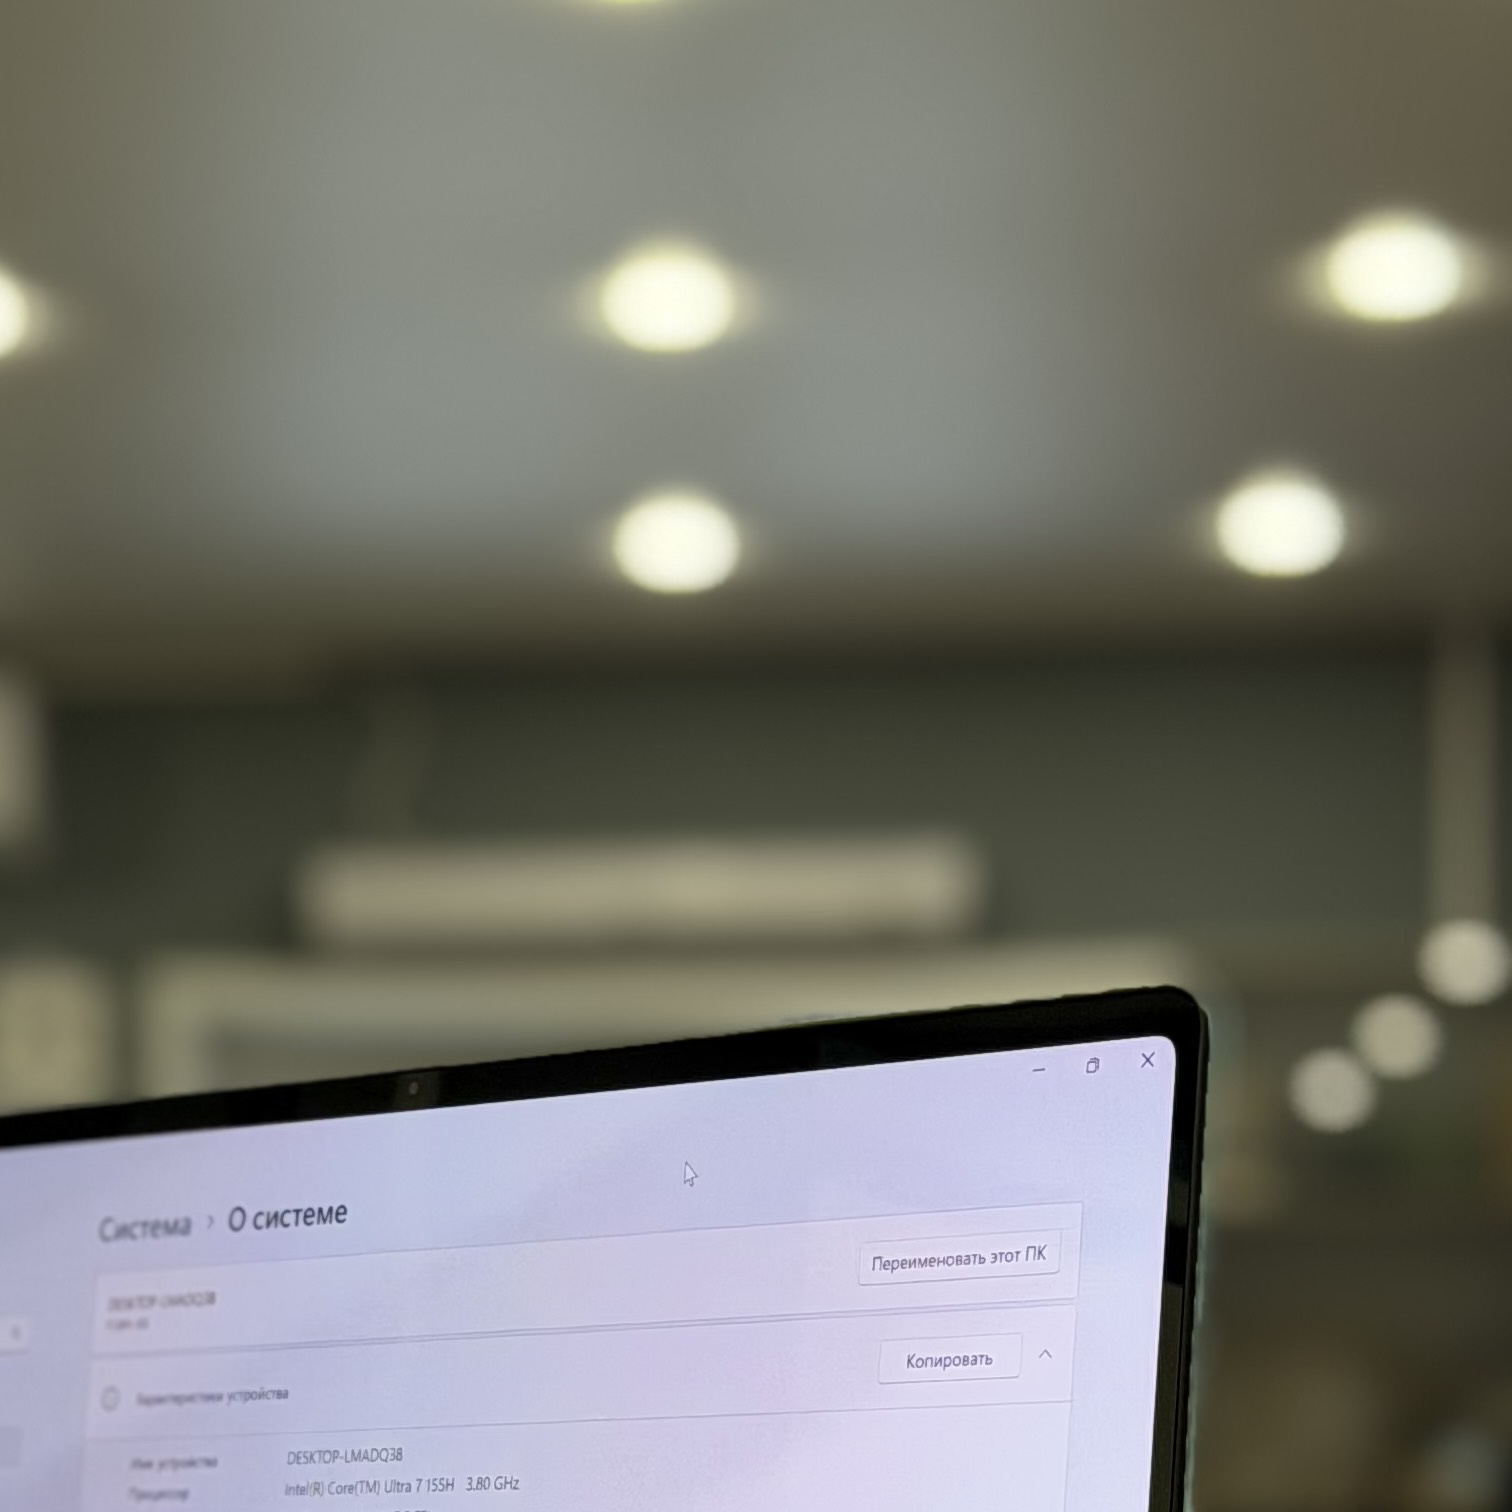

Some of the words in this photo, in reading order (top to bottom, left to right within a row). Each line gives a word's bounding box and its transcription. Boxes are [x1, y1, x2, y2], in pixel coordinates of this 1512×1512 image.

[228, 1206, 247, 1232] О
[253, 1204, 348, 1230] системе
[99, 1217, 192, 1243] Система
[872, 1248, 986, 1274] Переименовать
[990, 1246, 1021, 1266] этот
[1025, 1244, 1048, 1263] ПК
[906, 1350, 993, 1371] Копировать
[227, 1386, 289, 1405] устройства
[287, 1447, 403, 1465] DESKTOP-LMADQ38
[285, 1480, 324, 1497] Intel(R)
[328, 1479, 381, 1496] Core(TM)
[384, 1478, 412, 1494] Ultra
[415, 1478, 423, 1494] 7
[494, 1475, 520, 1490] GHz
